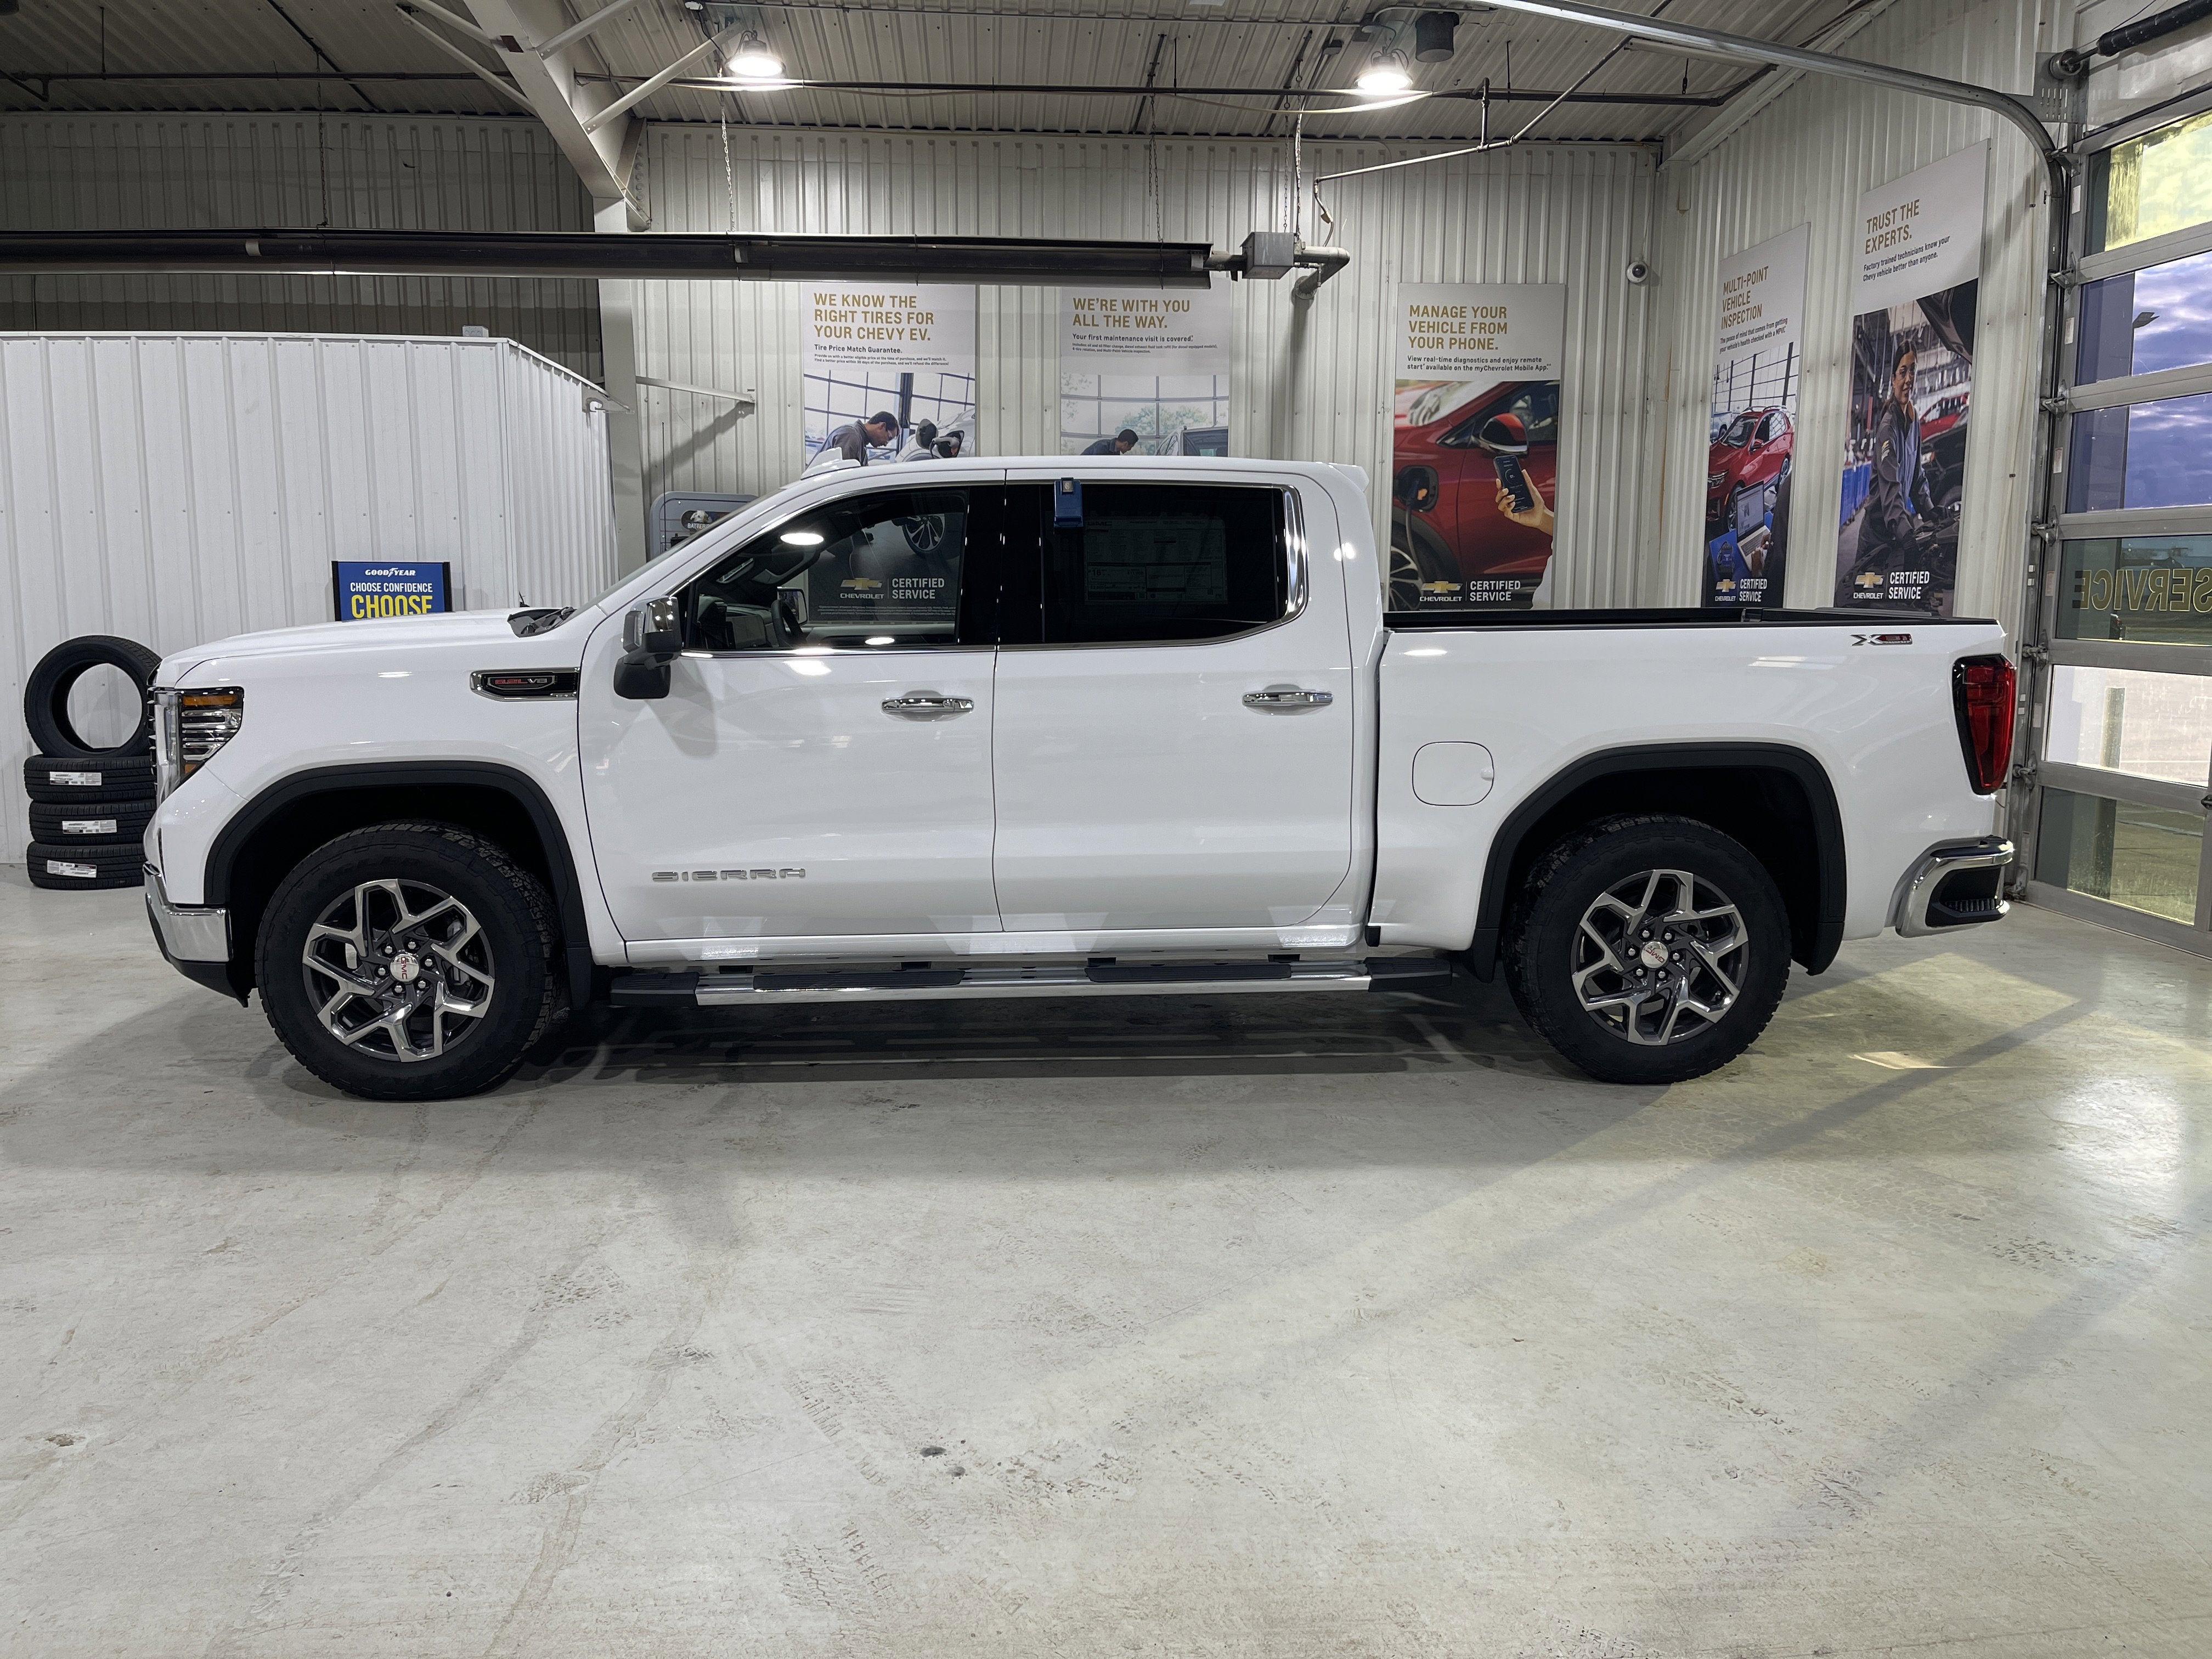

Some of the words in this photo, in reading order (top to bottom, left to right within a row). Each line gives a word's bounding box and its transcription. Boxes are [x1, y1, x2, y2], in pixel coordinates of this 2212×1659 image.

[1866, 208, 1897, 234] TRUST
[1900, 199, 1920, 221] THE
[1865, 224, 1912, 255] EXPERTS.
[1864, 261, 1880, 272] Factory
[1881, 254, 1897, 266] trained
[1897, 245, 1924, 260] technicians
[1925, 240, 1937, 251] know
[1938, 235, 1950, 247] your
[1863, 273, 1876, 281] Chevy
[1877, 267, 1892, 277] vehicle
[1893, 263, 1907, 273] better
[1908, 258, 1918, 267] than
[1920, 251, 1938, 263] anyone.
[1723, 266, 1769, 295] MULTI-POINT
[814, 292, 837, 306] WE
[842, 295, 885, 308] KNOW
[889, 295, 917, 308] THE
[1073, 297, 1117, 312] WE'RE
[1122, 299, 1158, 312] WITH
[1163, 300, 1190, 312] YOU
[1722, 290, 1751, 312] VEHICLE
[814, 309, 857, 323] RIGHT
[861, 311, 902, 324] TIRES
[907, 312, 934, 325] FOR
[1409, 305, 1467, 318] MANAGE
[1471, 306, 1507, 319] YOUR
[1721, 303, 1763, 330] INSPECTION
[1073, 313, 1099, 327] ALL
[1103, 315, 1130, 328] THE
[1135, 316, 1167, 329] WAY.
[1409, 320, 1466, 334] VEHICLE
[1470, 322, 1508, 334] FROM
[814, 325, 851, 339] YOUR
[857, 326, 905, 341] CHEVY
[910, 328, 930, 341] EV.
[1408, 336, 1444, 349] YOUR
[1449, 337, 1498, 350] PHONE.
[365, 567, 416, 577] GOODYEAR
[1889, 571, 1930, 584] CERTIFIED
[350, 582, 381, 592] CHOOSE
[383, 583, 433, 592] CONFIDENCE
[892, 578, 945, 588] CERTIFIED
[1470, 580, 1521, 590] CERTIFIED
[1740, 579, 1768, 589] CERTIFIED
[892, 589, 935, 599] SERVICE
[1470, 592, 1511, 601] SERVICE
[1739, 591, 1762, 602] SERVICE
[1888, 586, 1921, 599] SERVICE
[351, 595, 433, 619] CHOOSE
[652, 868, 805, 882] SIERRA
[1645, 947, 1665, 963] GMC
